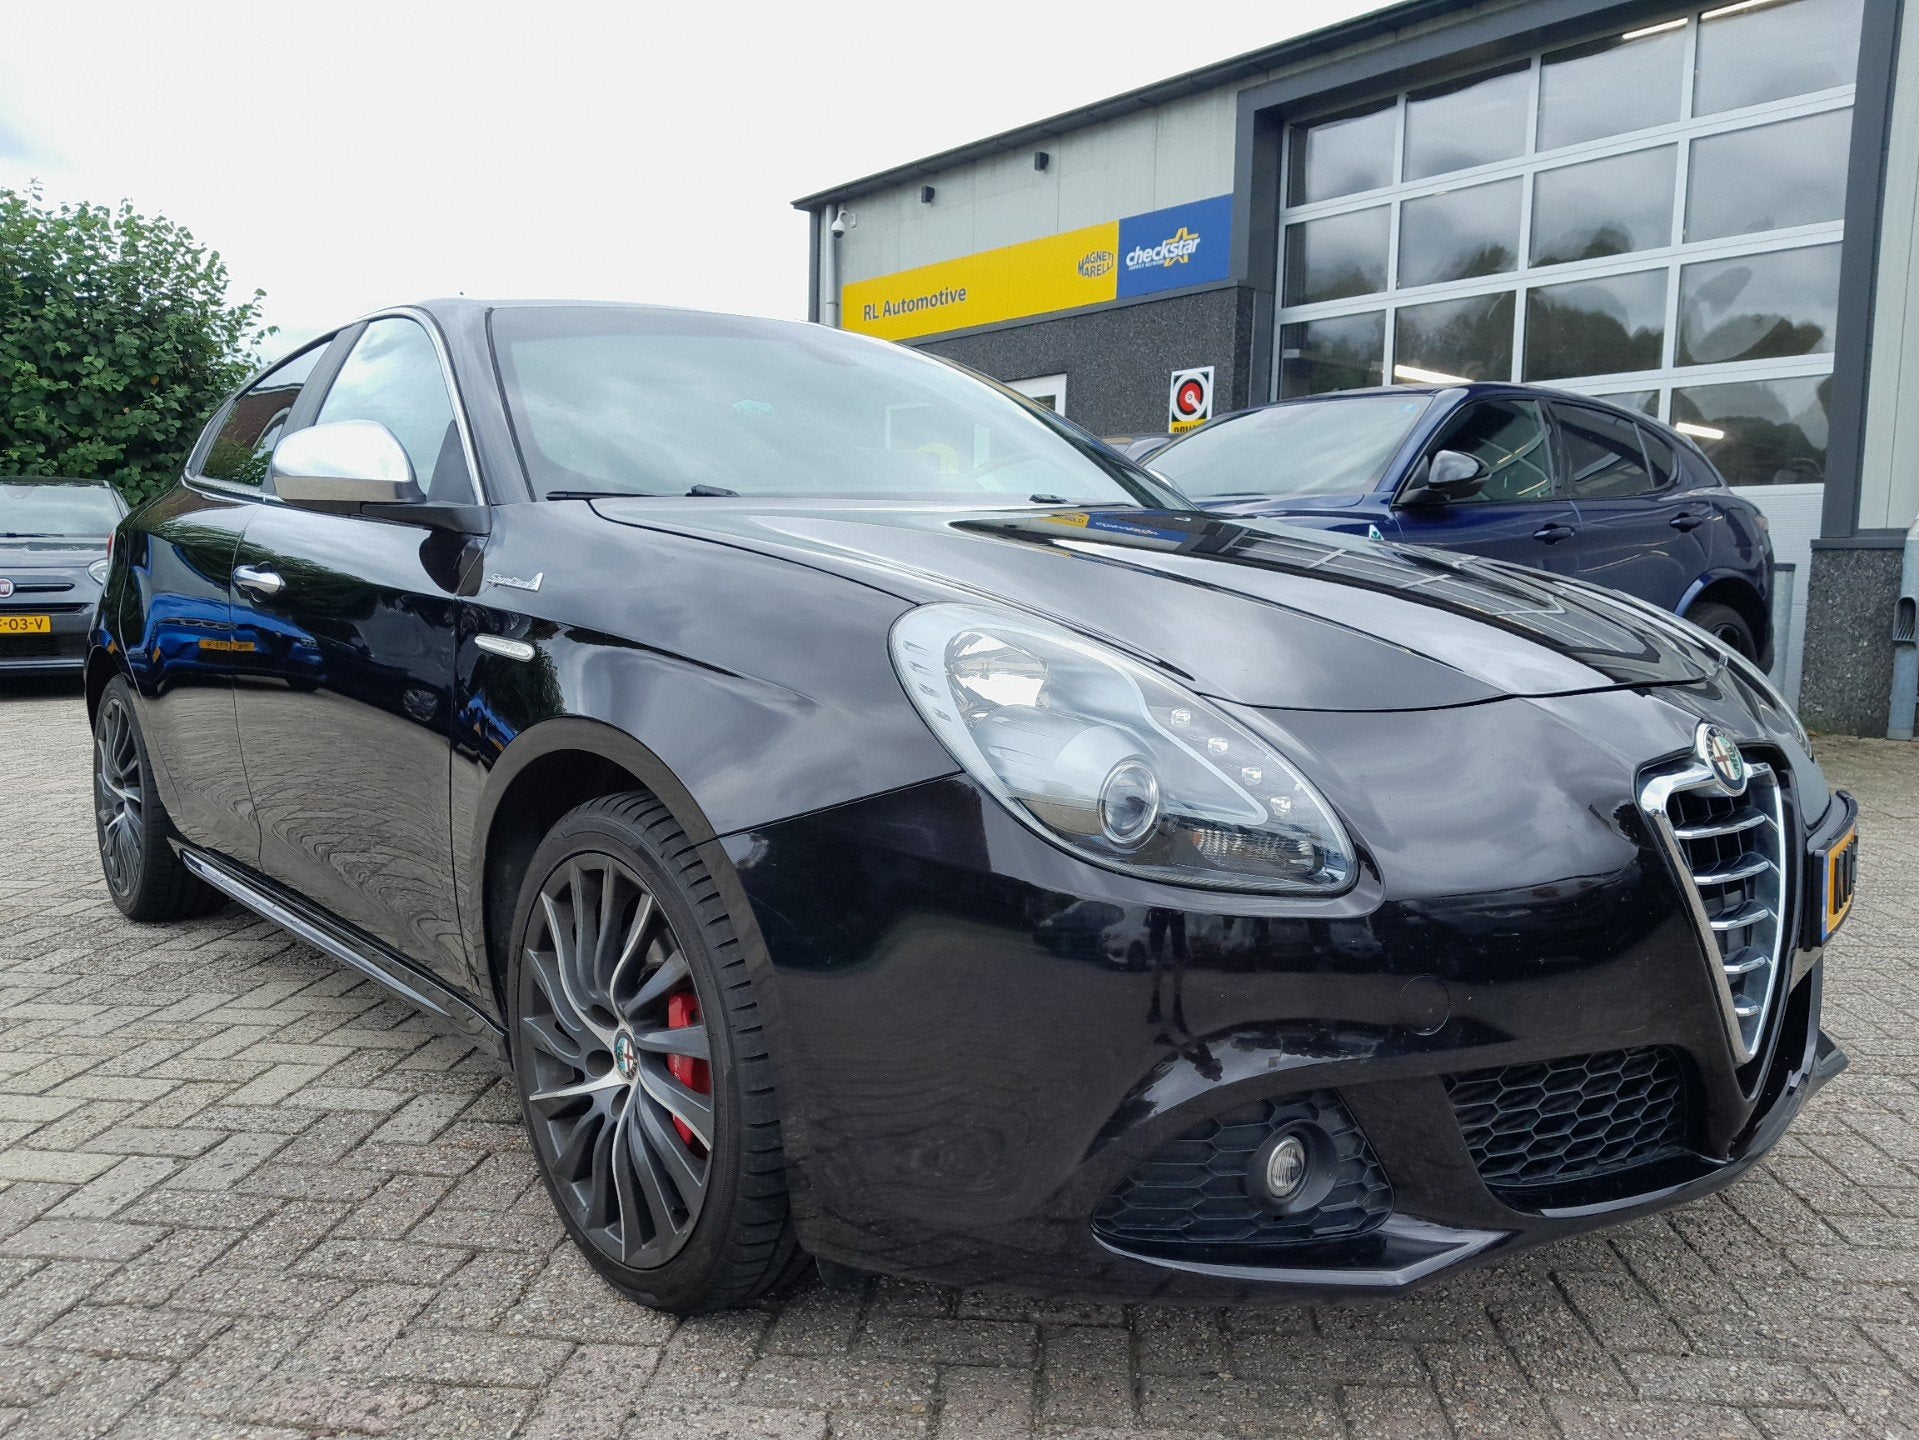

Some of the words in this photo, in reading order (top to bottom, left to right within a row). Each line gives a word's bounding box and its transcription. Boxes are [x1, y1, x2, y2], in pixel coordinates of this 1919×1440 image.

[1078, 250, 1114, 268] MAGNETI
[1126, 238, 1200, 267] checkstar
[1078, 261, 1114, 278] MARELLI
[864, 303, 879, 321] RL
[883, 287, 966, 317] Automotive
[0, 618, 43, 631] -03-V
